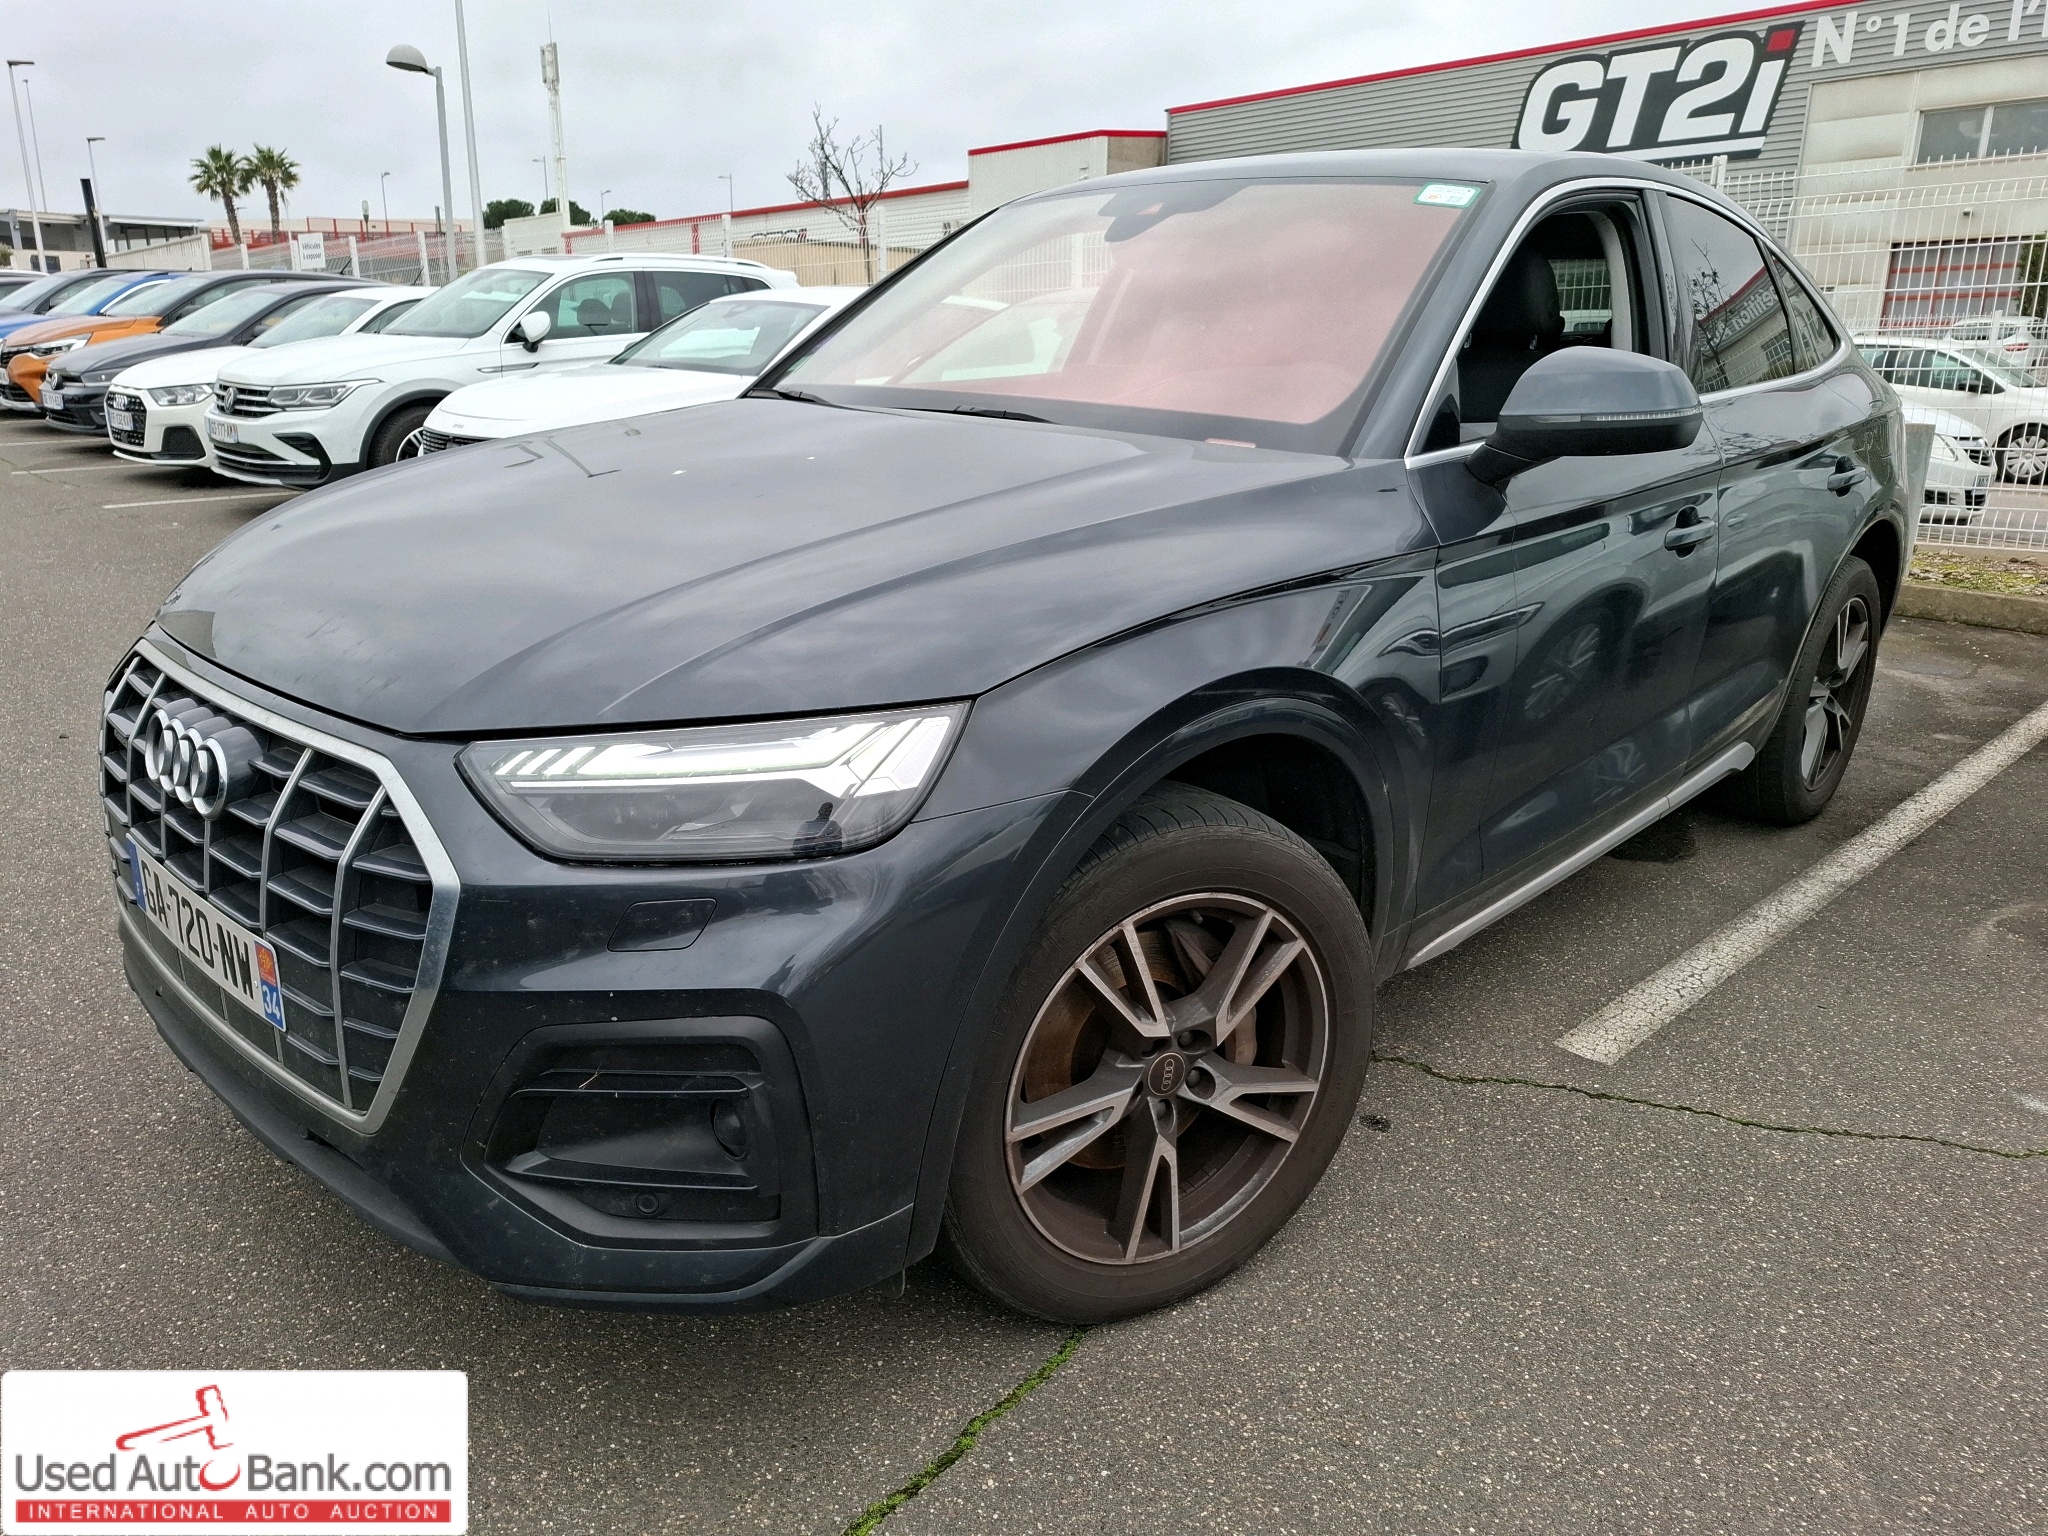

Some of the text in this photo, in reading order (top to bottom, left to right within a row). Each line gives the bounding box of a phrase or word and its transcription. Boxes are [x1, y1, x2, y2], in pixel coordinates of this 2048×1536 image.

[1925, 3, 1990, 51] de
[2007, 0, 2048, 41] l'
[1518, 28, 1796, 151] GT2i
[141, 859, 254, 1000] GA-720-NW
[262, 985, 281, 1021] 34
